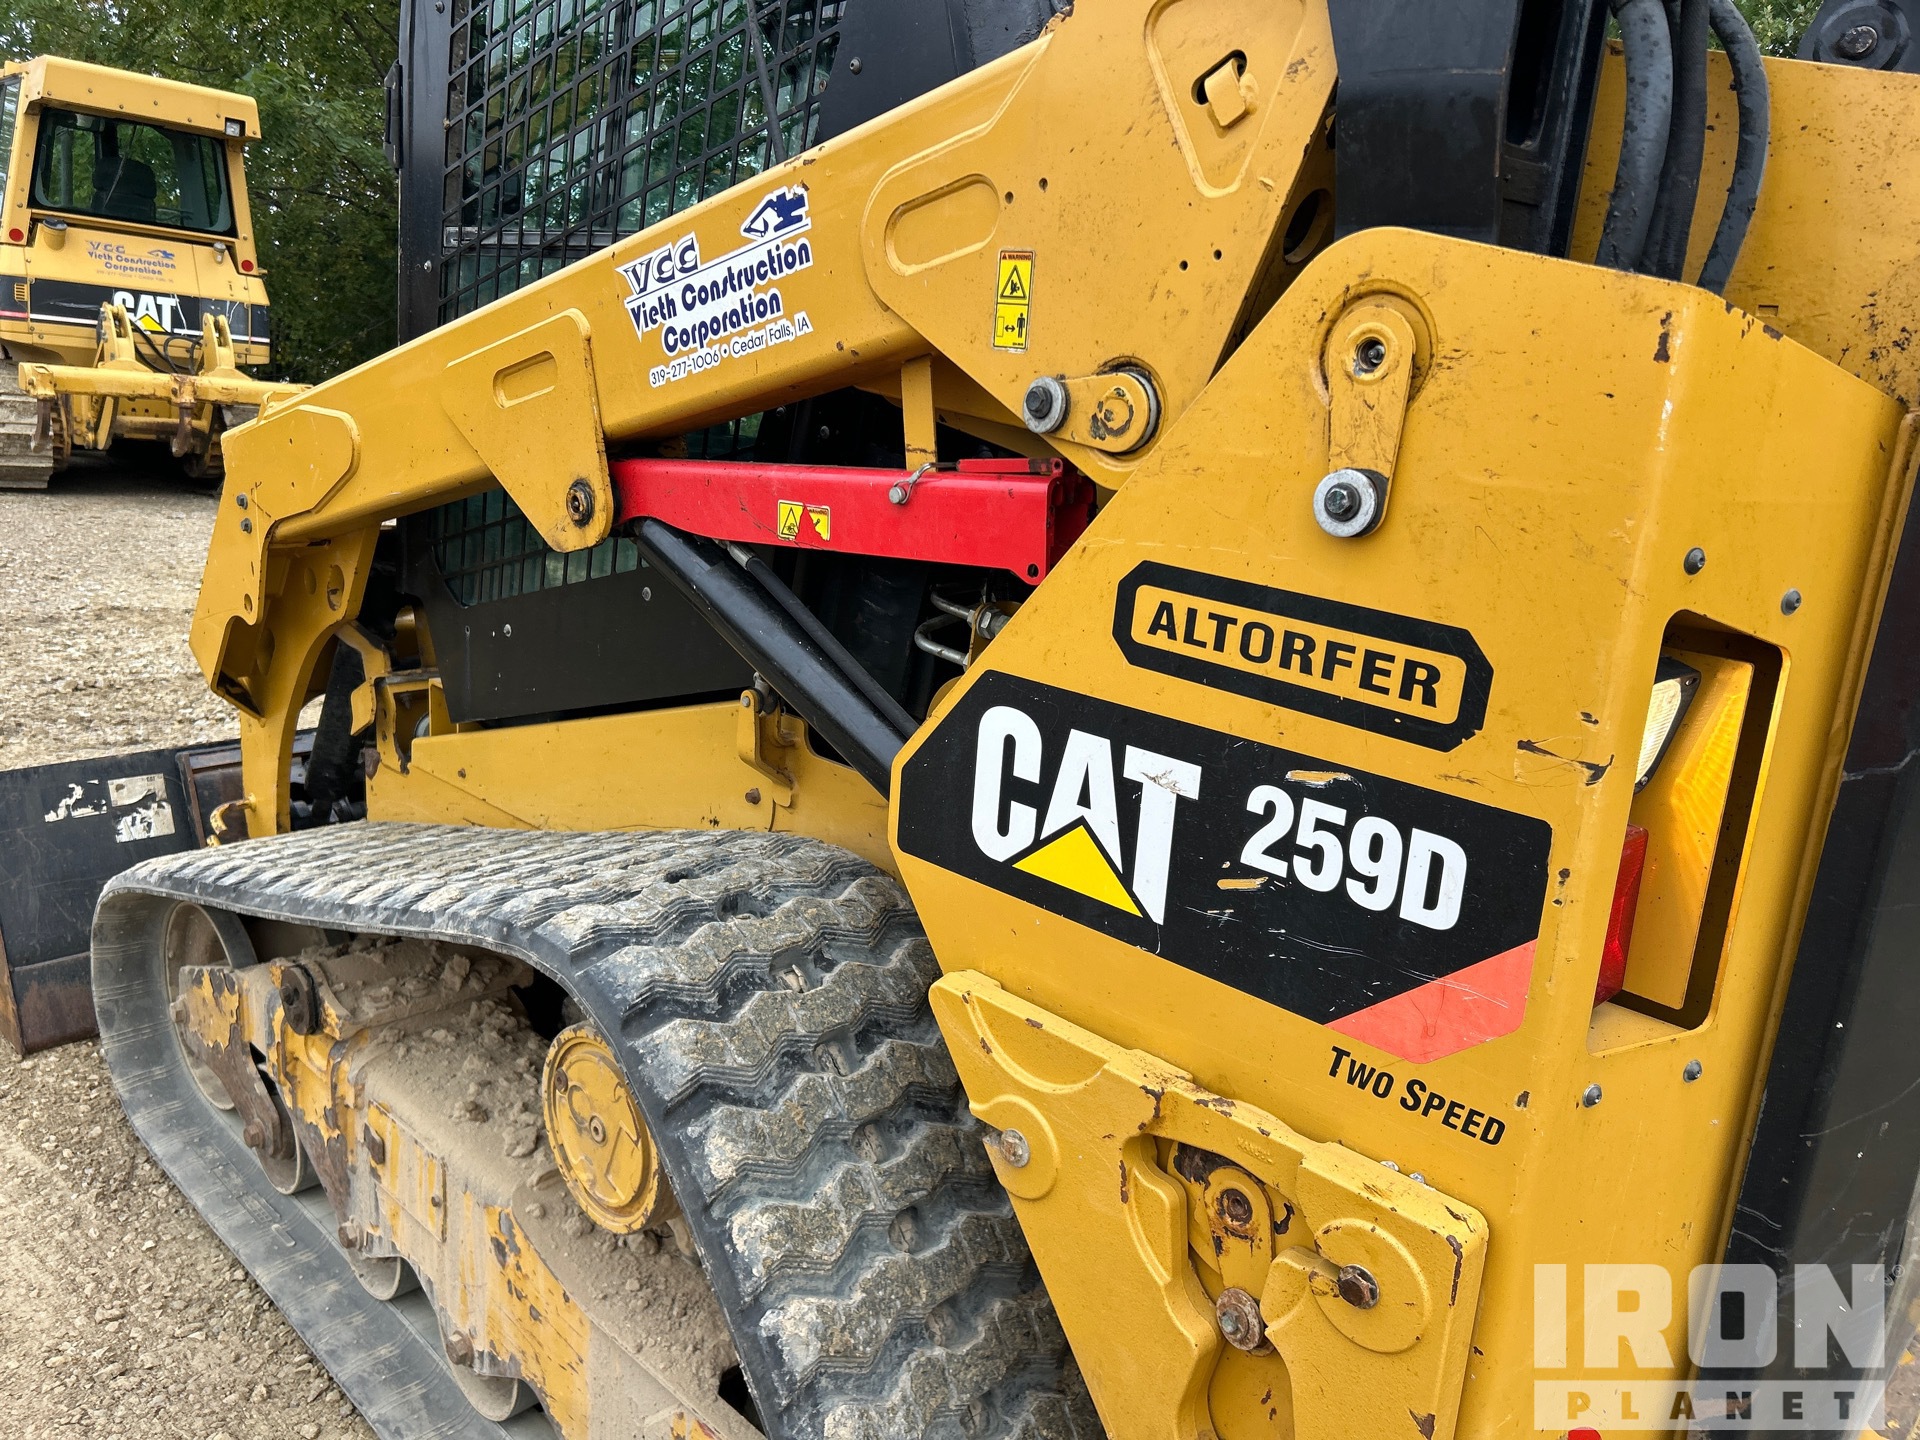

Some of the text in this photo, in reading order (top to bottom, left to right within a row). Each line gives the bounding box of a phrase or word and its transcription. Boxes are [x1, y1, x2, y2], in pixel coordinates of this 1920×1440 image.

[87, 250, 176, 270] Vieth Construction
[89, 241, 126, 255] VCC
[105, 261, 163, 276] Corporation
[623, 237, 699, 295] VCC
[1007, 253, 1032, 261] WARNING
[113, 290, 177, 333] CAT
[630, 242, 811, 331] Vieth Construction
[651, 316, 810, 386] 319-277-1006 Cedar Falls, IA
[663, 292, 782, 354] Corporation
[1147, 600, 1442, 708] ALTORFER
[971, 705, 1468, 931] CAT 259D
